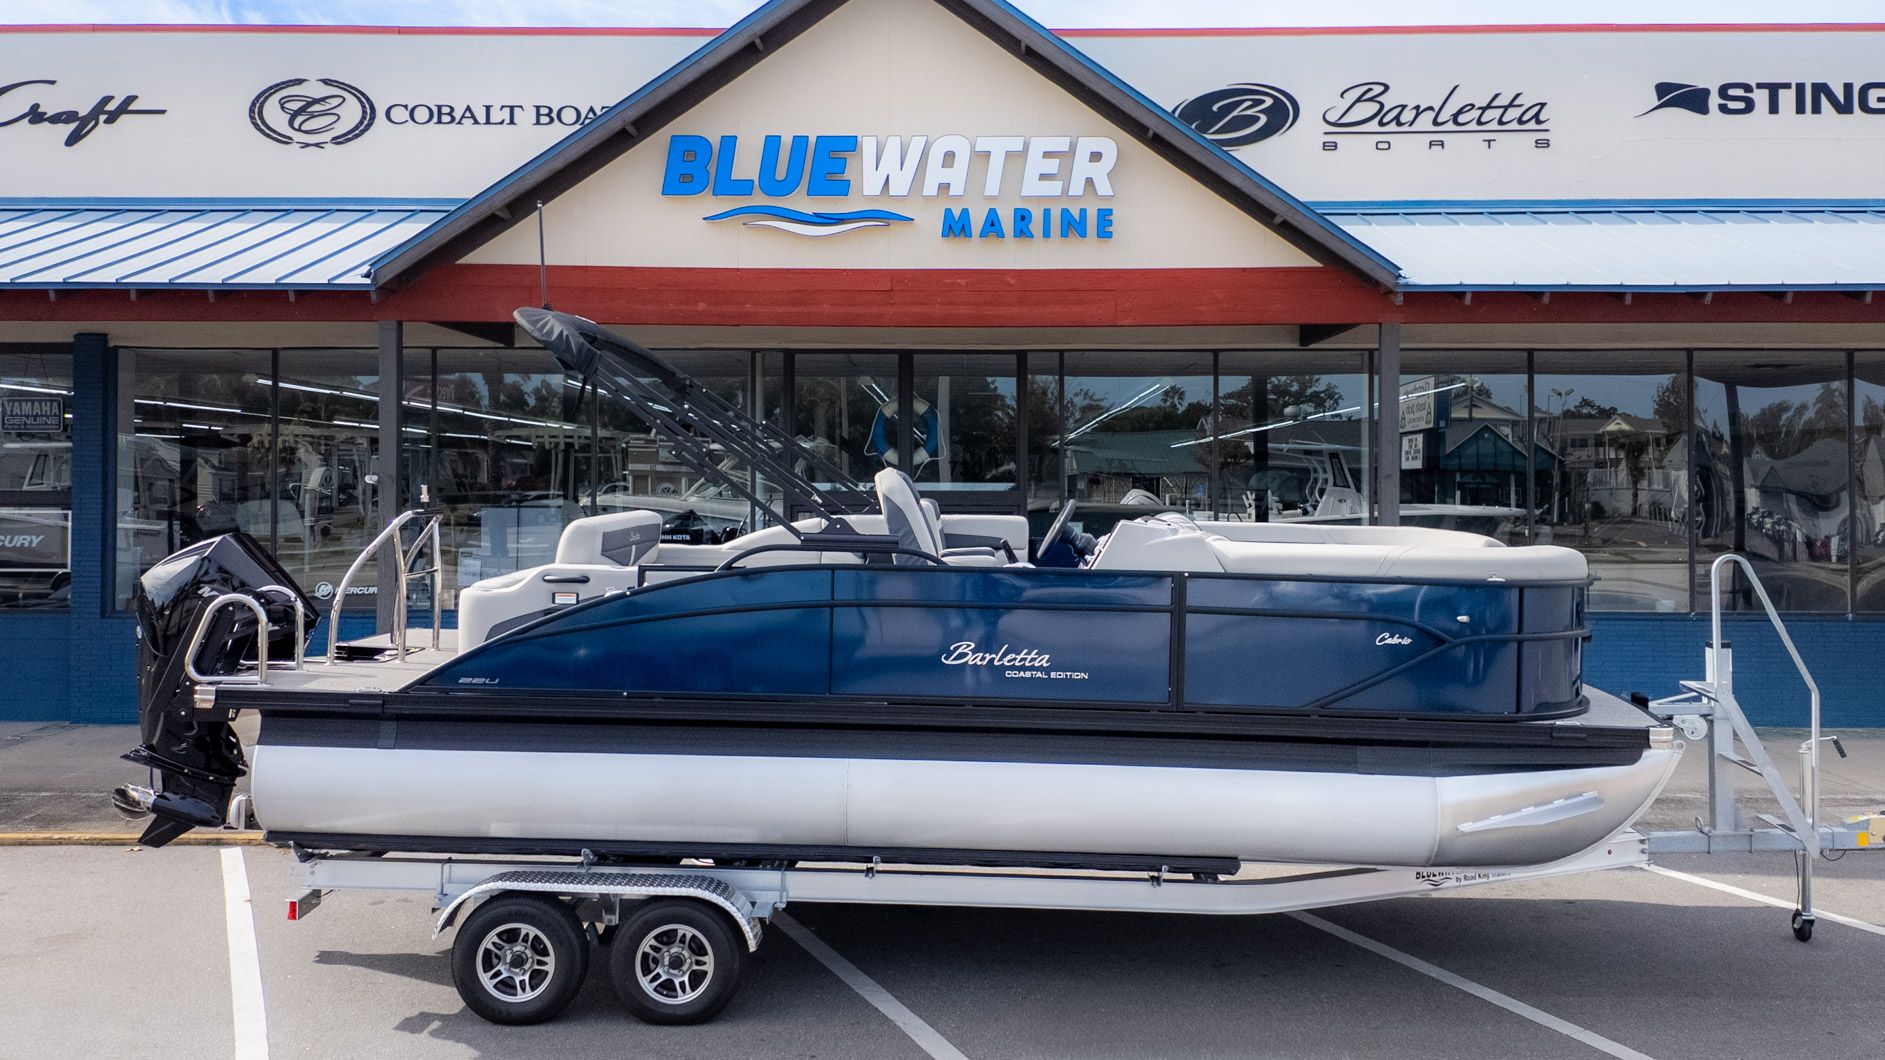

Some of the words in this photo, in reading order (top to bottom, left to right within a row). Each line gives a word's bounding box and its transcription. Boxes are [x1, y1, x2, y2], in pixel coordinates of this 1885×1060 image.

[1322, 81, 1550, 128] Barletta
[385, 104, 524, 126] COBALT
[1322, 138, 1551, 151] BOATS
[661, 134, 1118, 197] BLUEWATER
[941, 207, 1114, 239] MARINE
[3, 400, 60, 416] YAMAHA
[4, 416, 60, 425] GENUINE
[1375, 632, 1412, 646] Cabrio
[941, 641, 1051, 667] Barletta
[1005, 670, 1049, 679] COASTAL
[1050, 671, 1089, 680] EDITION
[1455, 876, 1462, 884] by
[1478, 872, 1490, 881] King
